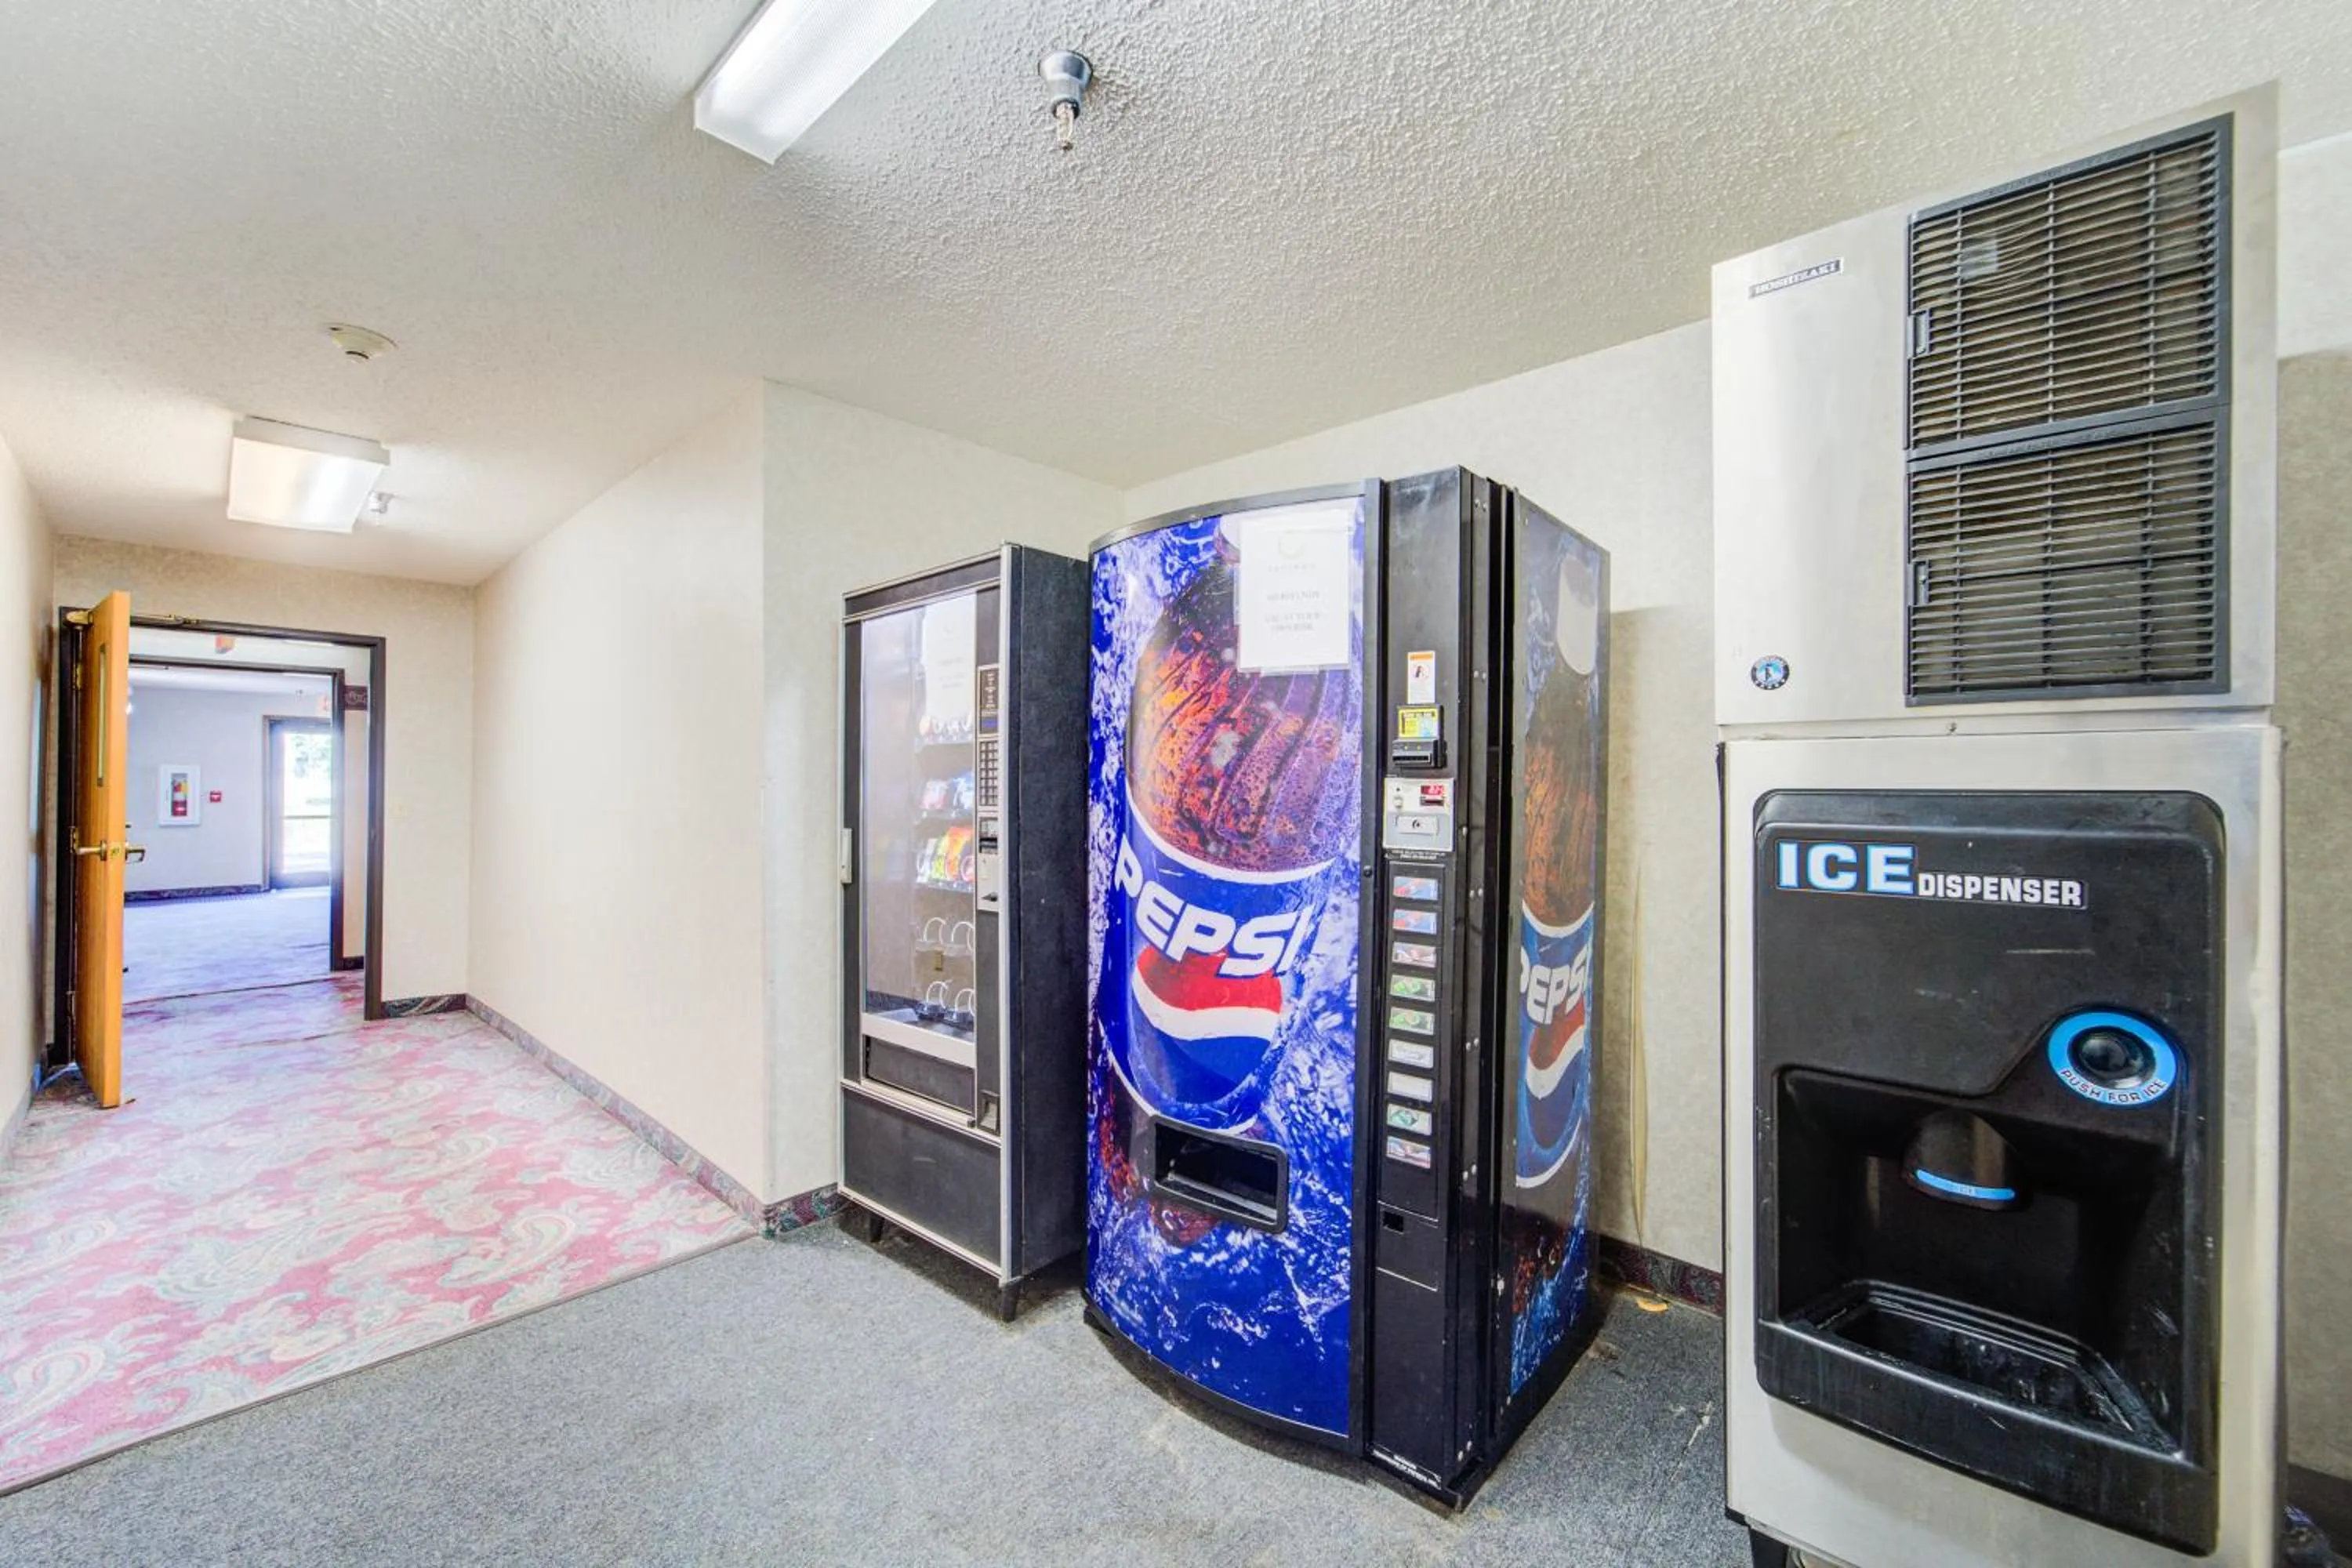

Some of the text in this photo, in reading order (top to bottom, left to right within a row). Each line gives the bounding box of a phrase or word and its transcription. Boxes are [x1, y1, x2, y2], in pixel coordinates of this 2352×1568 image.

[1114, 833, 1316, 976] PEPSI
[1778, 841, 2082, 906] ICE DISPENSER
[2060, 1068, 2167, 1103] PUSH FOR ICE
